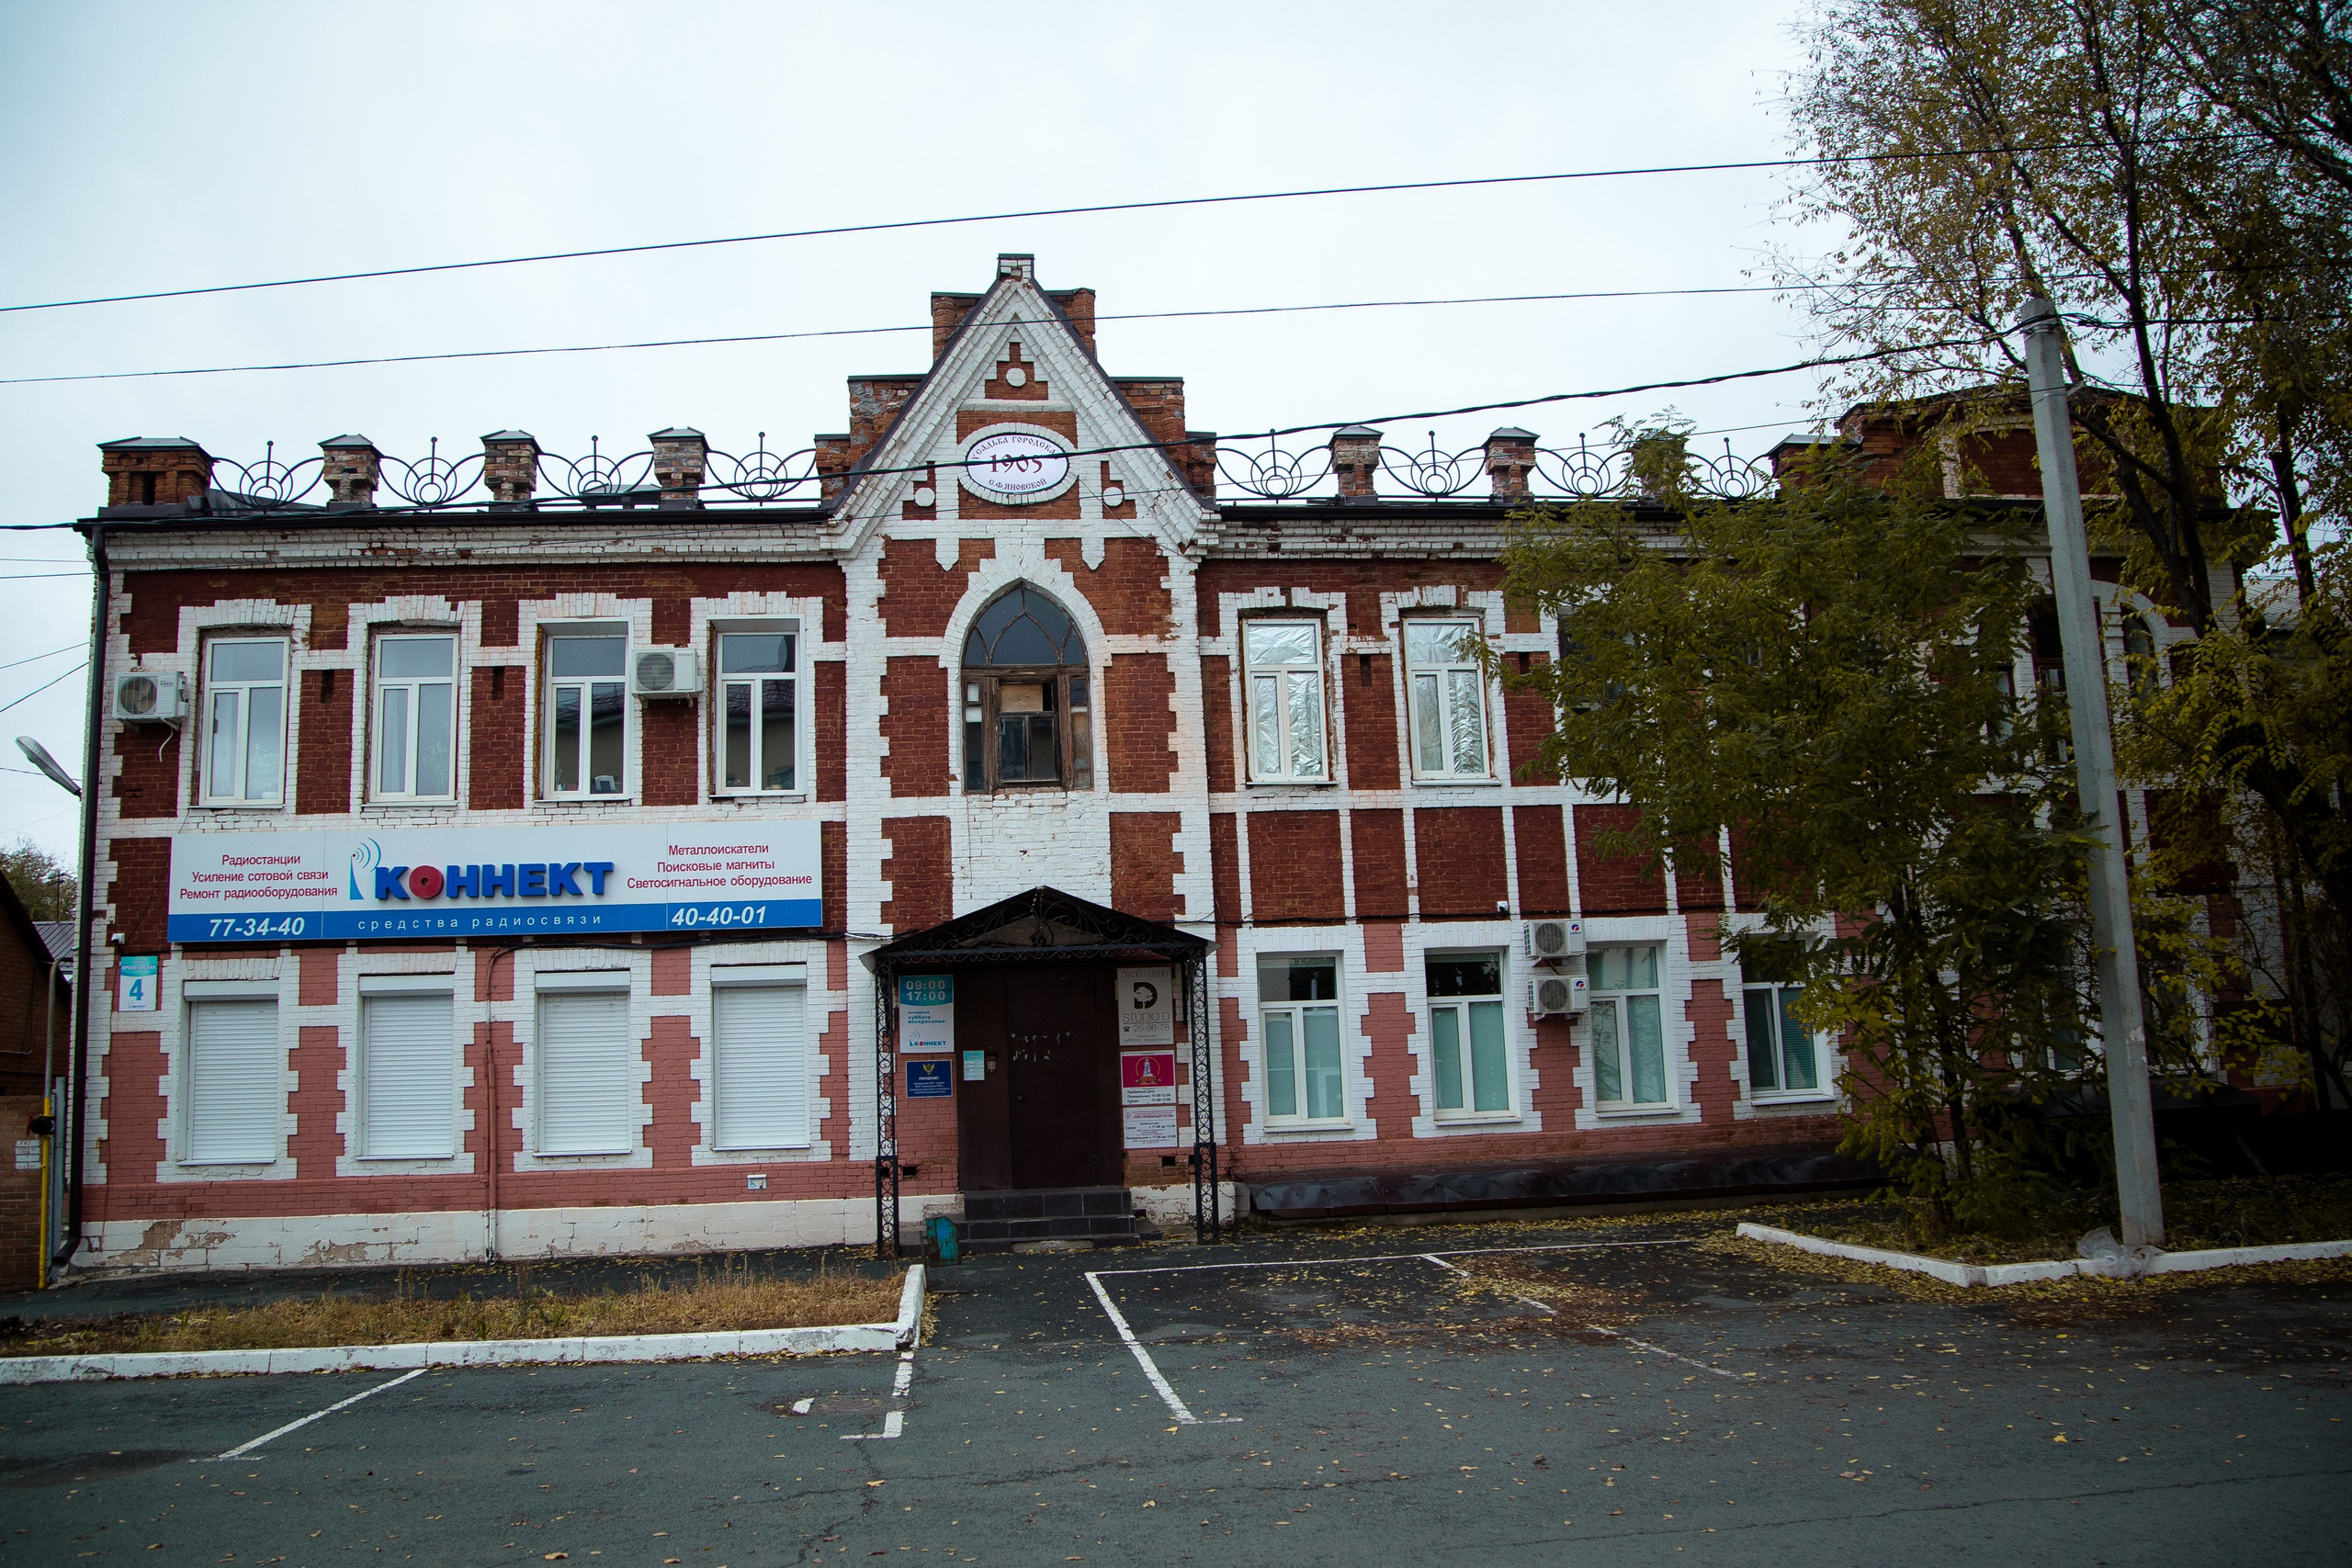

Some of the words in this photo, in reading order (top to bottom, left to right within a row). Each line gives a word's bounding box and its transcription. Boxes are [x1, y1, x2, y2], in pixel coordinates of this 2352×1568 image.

[972, 436, 1009, 459] УСАДЬБА
[1012, 436, 1059, 460] ГОРОДСКА
[989, 454, 1043, 474] 1905
[668, 843, 769, 856] Металлоискатели
[221, 853, 301, 866] Радиостанции
[657, 860, 722, 873] Поисковые
[726, 859, 775, 871] магниты
[191, 872, 244, 883] Усиление
[247, 871, 294, 882] сотовой
[297, 870, 329, 880] связи
[374, 862, 615, 901] КОННЕКТ
[627, 875, 727, 889] Светосигнальное
[730, 874, 812, 888] оборудование
[180, 887, 220, 899] Ремонт
[223, 886, 338, 900] радиооборудования
[357, 919, 458, 931] средства
[471, 915, 601, 930] радиосвязи
[671, 906, 767, 926] 40-40-01
[209, 917, 305, 937] 77-34-40
[129, 979, 143, 1001] 4
[906, 980, 945, 990] 09:00
[906, 991, 945, 1001] 17:00
[1122, 1011, 1160, 1022] STUDIO
[1162, 1011, 1170, 1021] D
